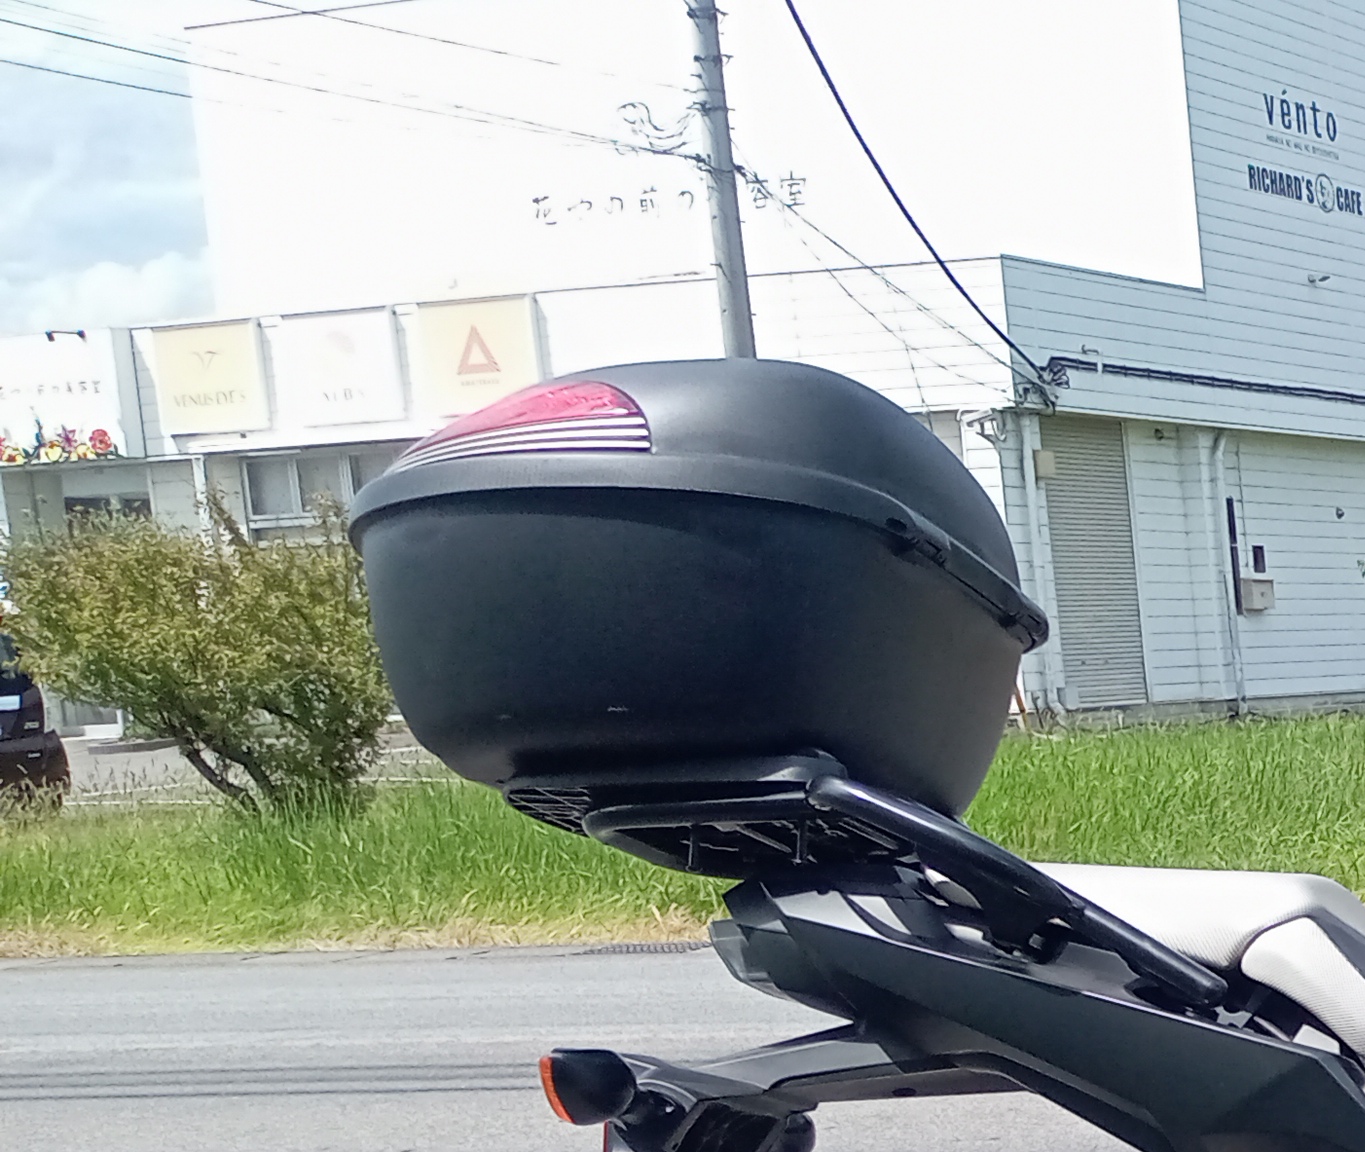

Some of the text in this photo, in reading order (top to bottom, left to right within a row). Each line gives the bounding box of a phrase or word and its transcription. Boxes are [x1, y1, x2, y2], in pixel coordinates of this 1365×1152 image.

[1263, 89, 1338, 142] vénto
[1247, 163, 1363, 216] RICHARD'S CAFE
